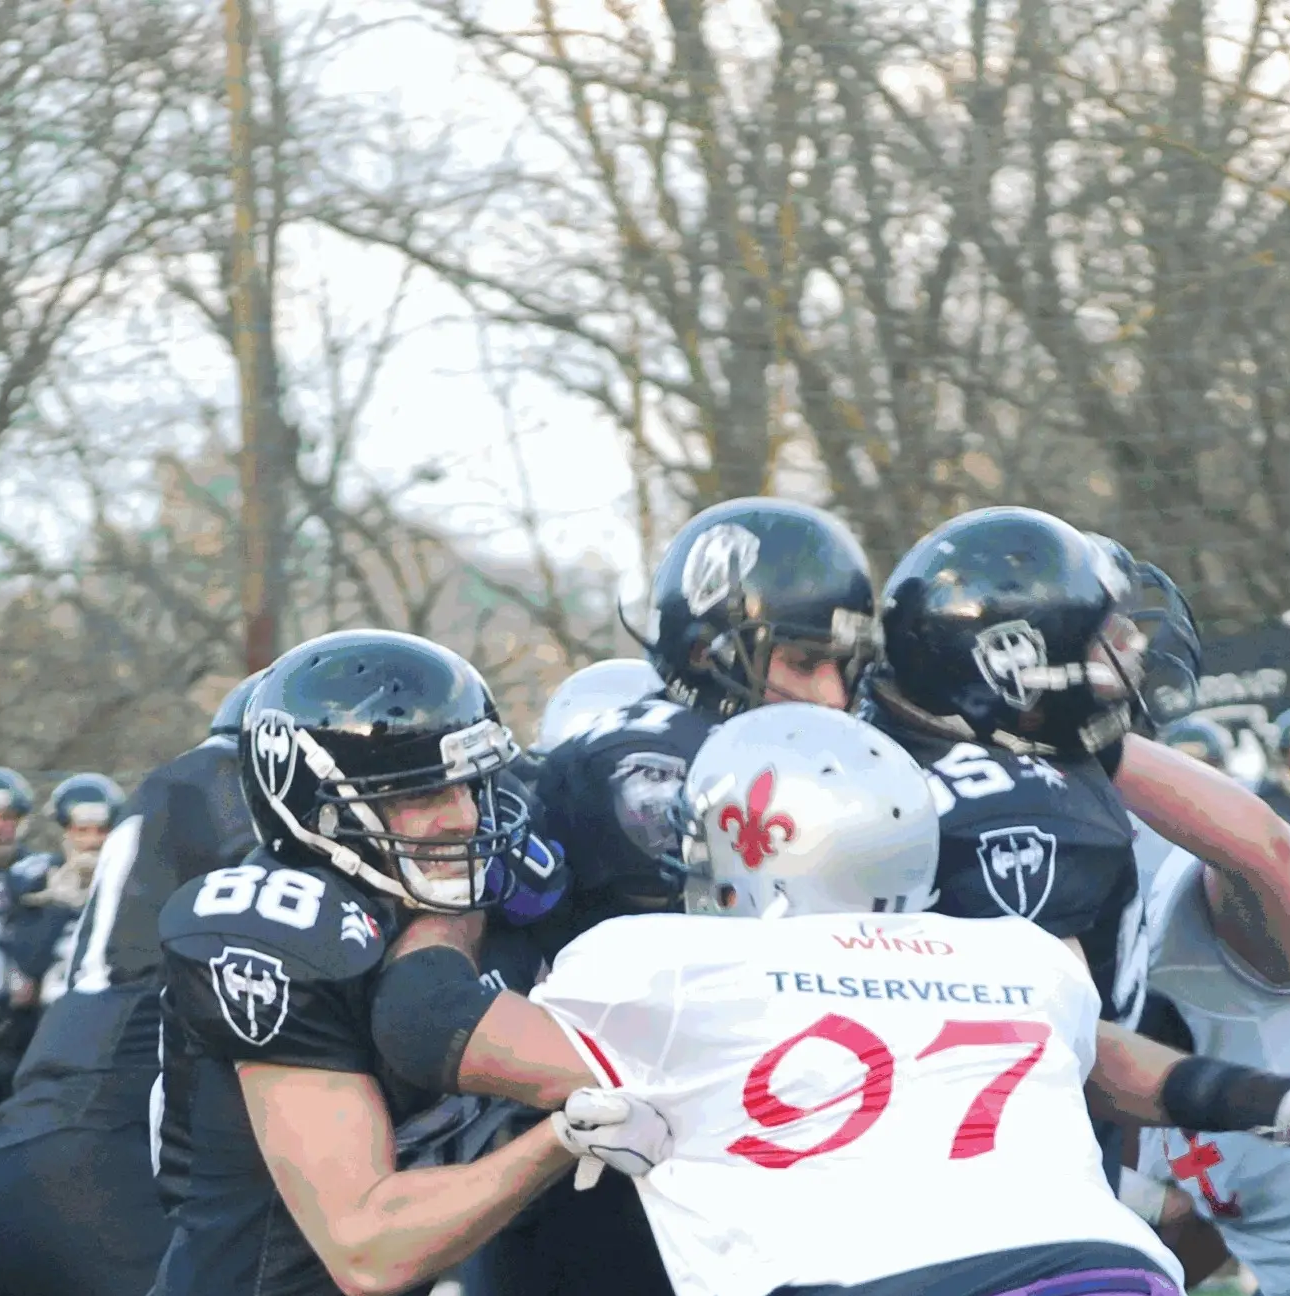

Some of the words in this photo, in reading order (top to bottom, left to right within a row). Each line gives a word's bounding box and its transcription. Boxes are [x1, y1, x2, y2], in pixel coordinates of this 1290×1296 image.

[192, 864, 327, 930] 88
[765, 970, 1035, 1006] TELSERVICE.IT
[724, 1011, 1053, 1170] 97
